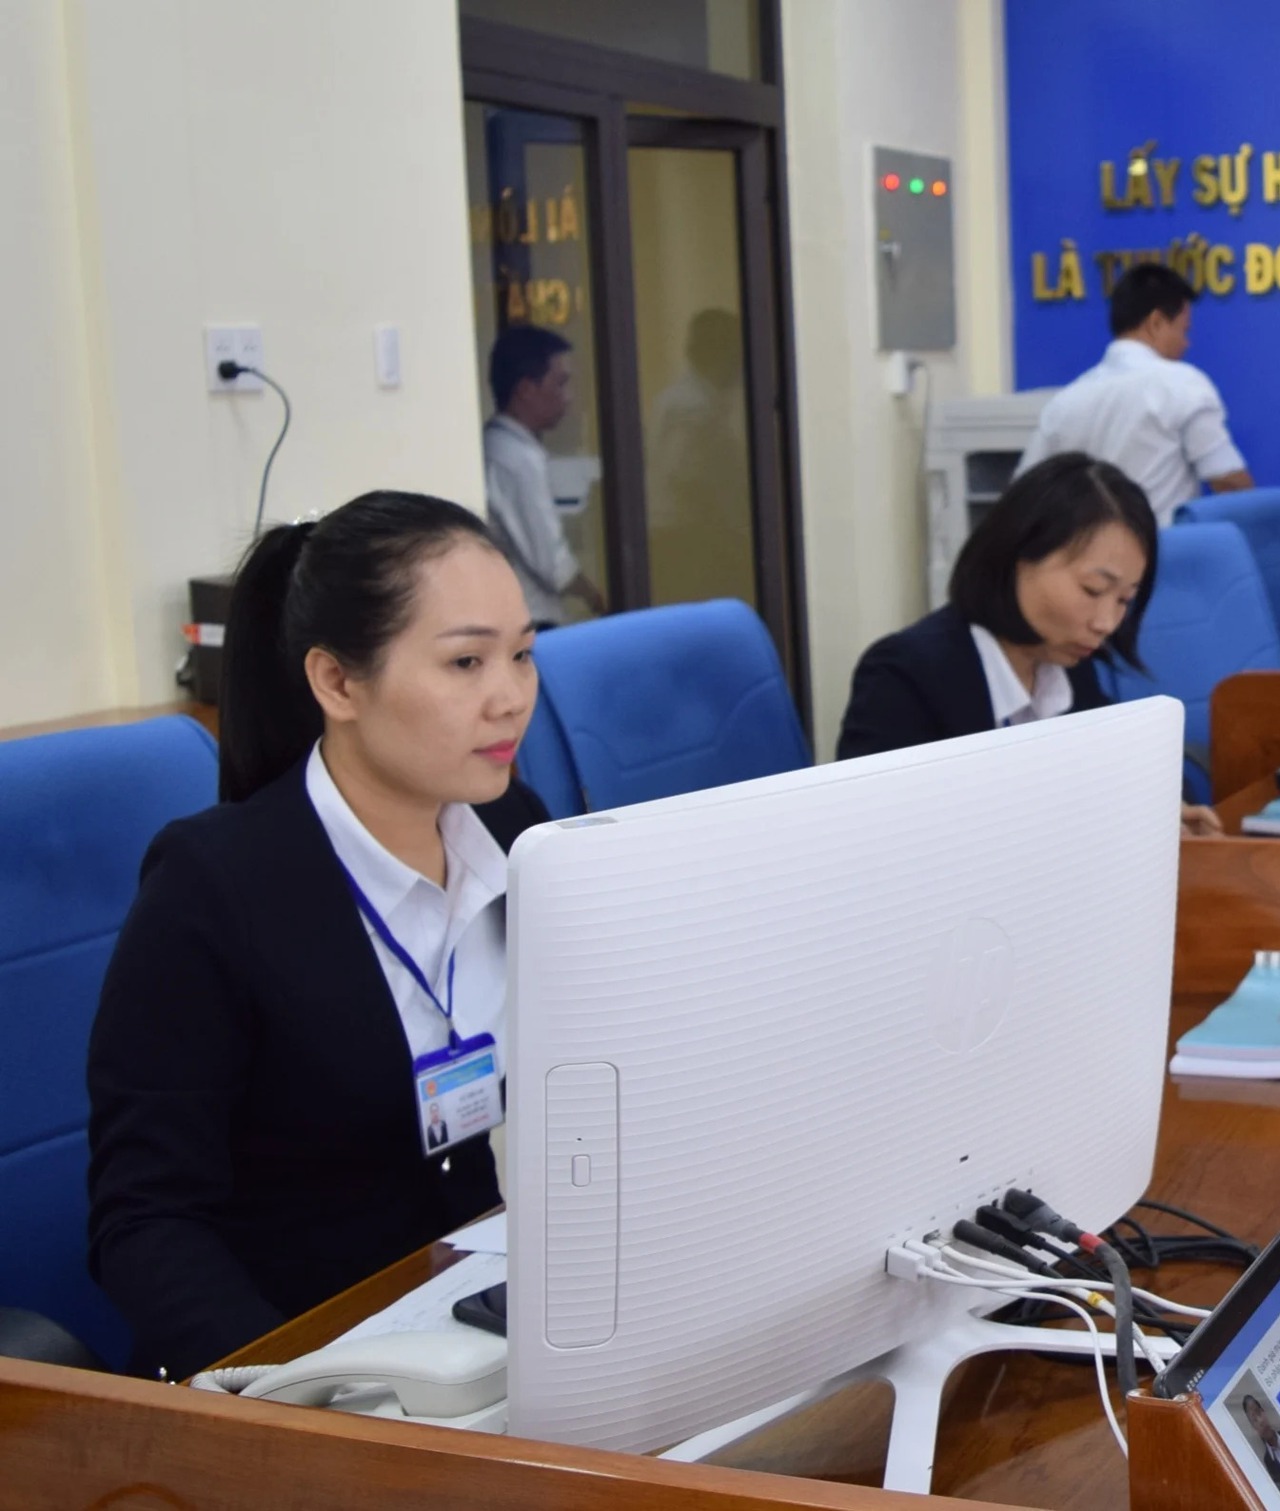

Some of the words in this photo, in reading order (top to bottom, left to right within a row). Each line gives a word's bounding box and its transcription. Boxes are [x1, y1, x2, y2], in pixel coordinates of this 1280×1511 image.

[1100, 139, 1181, 210] LẤY
[1193, 143, 1253, 216] SỰ
[1031, 237, 1086, 300] LÀ
